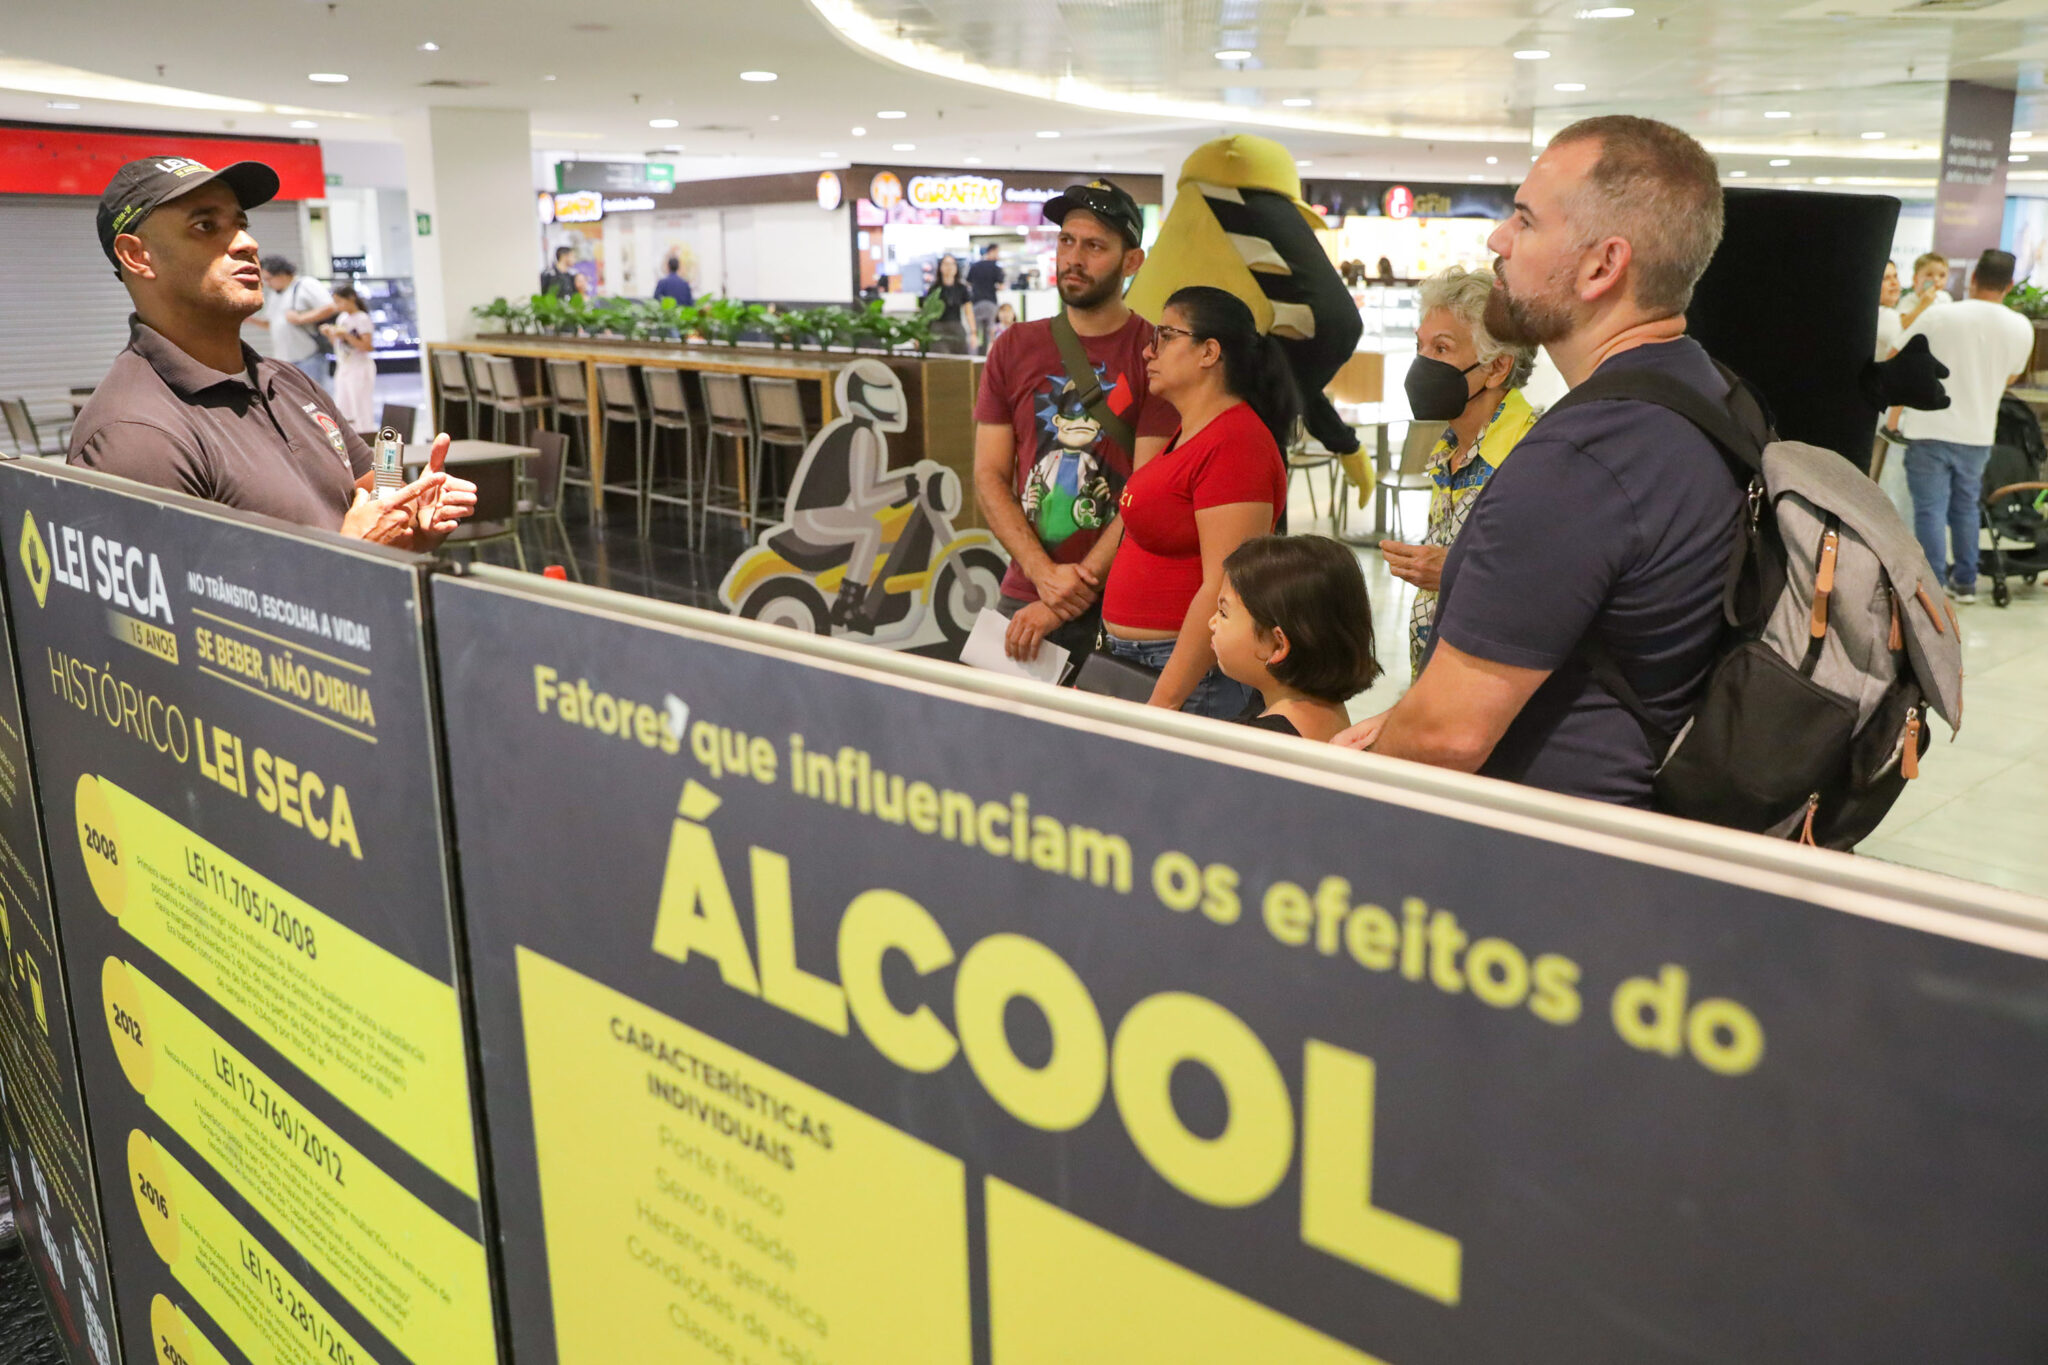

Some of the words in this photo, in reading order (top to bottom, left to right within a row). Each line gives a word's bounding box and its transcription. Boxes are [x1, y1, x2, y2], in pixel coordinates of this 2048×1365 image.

[911, 179, 1000, 207] GIRAFFAS
[48, 521, 91, 594] LEI
[92, 535, 174, 625] SECA
[187, 571, 205, 597] NO
[206, 573, 262, 617] TRÂNSITO,
[262, 594, 318, 634] ESCOLHA
[320, 616, 332, 639] A
[333, 619, 372, 652] VIDA!
[130, 621, 142, 642] 15
[145, 626, 176, 659] ANOS
[196, 626, 216, 659] SE
[217, 633, 269, 690] BEBER,
[270, 650, 311, 701] NÃO
[313, 669, 377, 728] DIRIJA
[47, 645, 189, 764] HISTÓRICO
[194, 717, 248, 798] LEI
[253, 747, 364, 860] SECA
[84, 823, 118, 867] 2008
[533, 664, 681, 756] Fatores
[691, 720, 778, 785] que
[790, 732, 1132, 894] influenciam
[1152, 850, 1240, 926] os
[1262, 874, 1580, 1026] efeitos
[1610, 965, 1765, 1077] do
[184, 846, 209, 888] LEI
[211, 864, 317, 960] 11.705/2008
[112, 1002, 144, 1048] 2012
[652, 779, 1462, 1307] ÁLCOOL
[213, 1048, 236, 1091] LEI
[238, 1072, 345, 1187] 12.760/2012
[609, 1016, 834, 1151] CARACTERÍSTICAS
[647, 1072, 795, 1171] INDIVIDUAIS
[138, 1172, 168, 1220] 2016
[655, 1166, 706, 1216] Sexo
[658, 1124, 717, 1180] Porte
[240, 1239, 263, 1285] LEI
